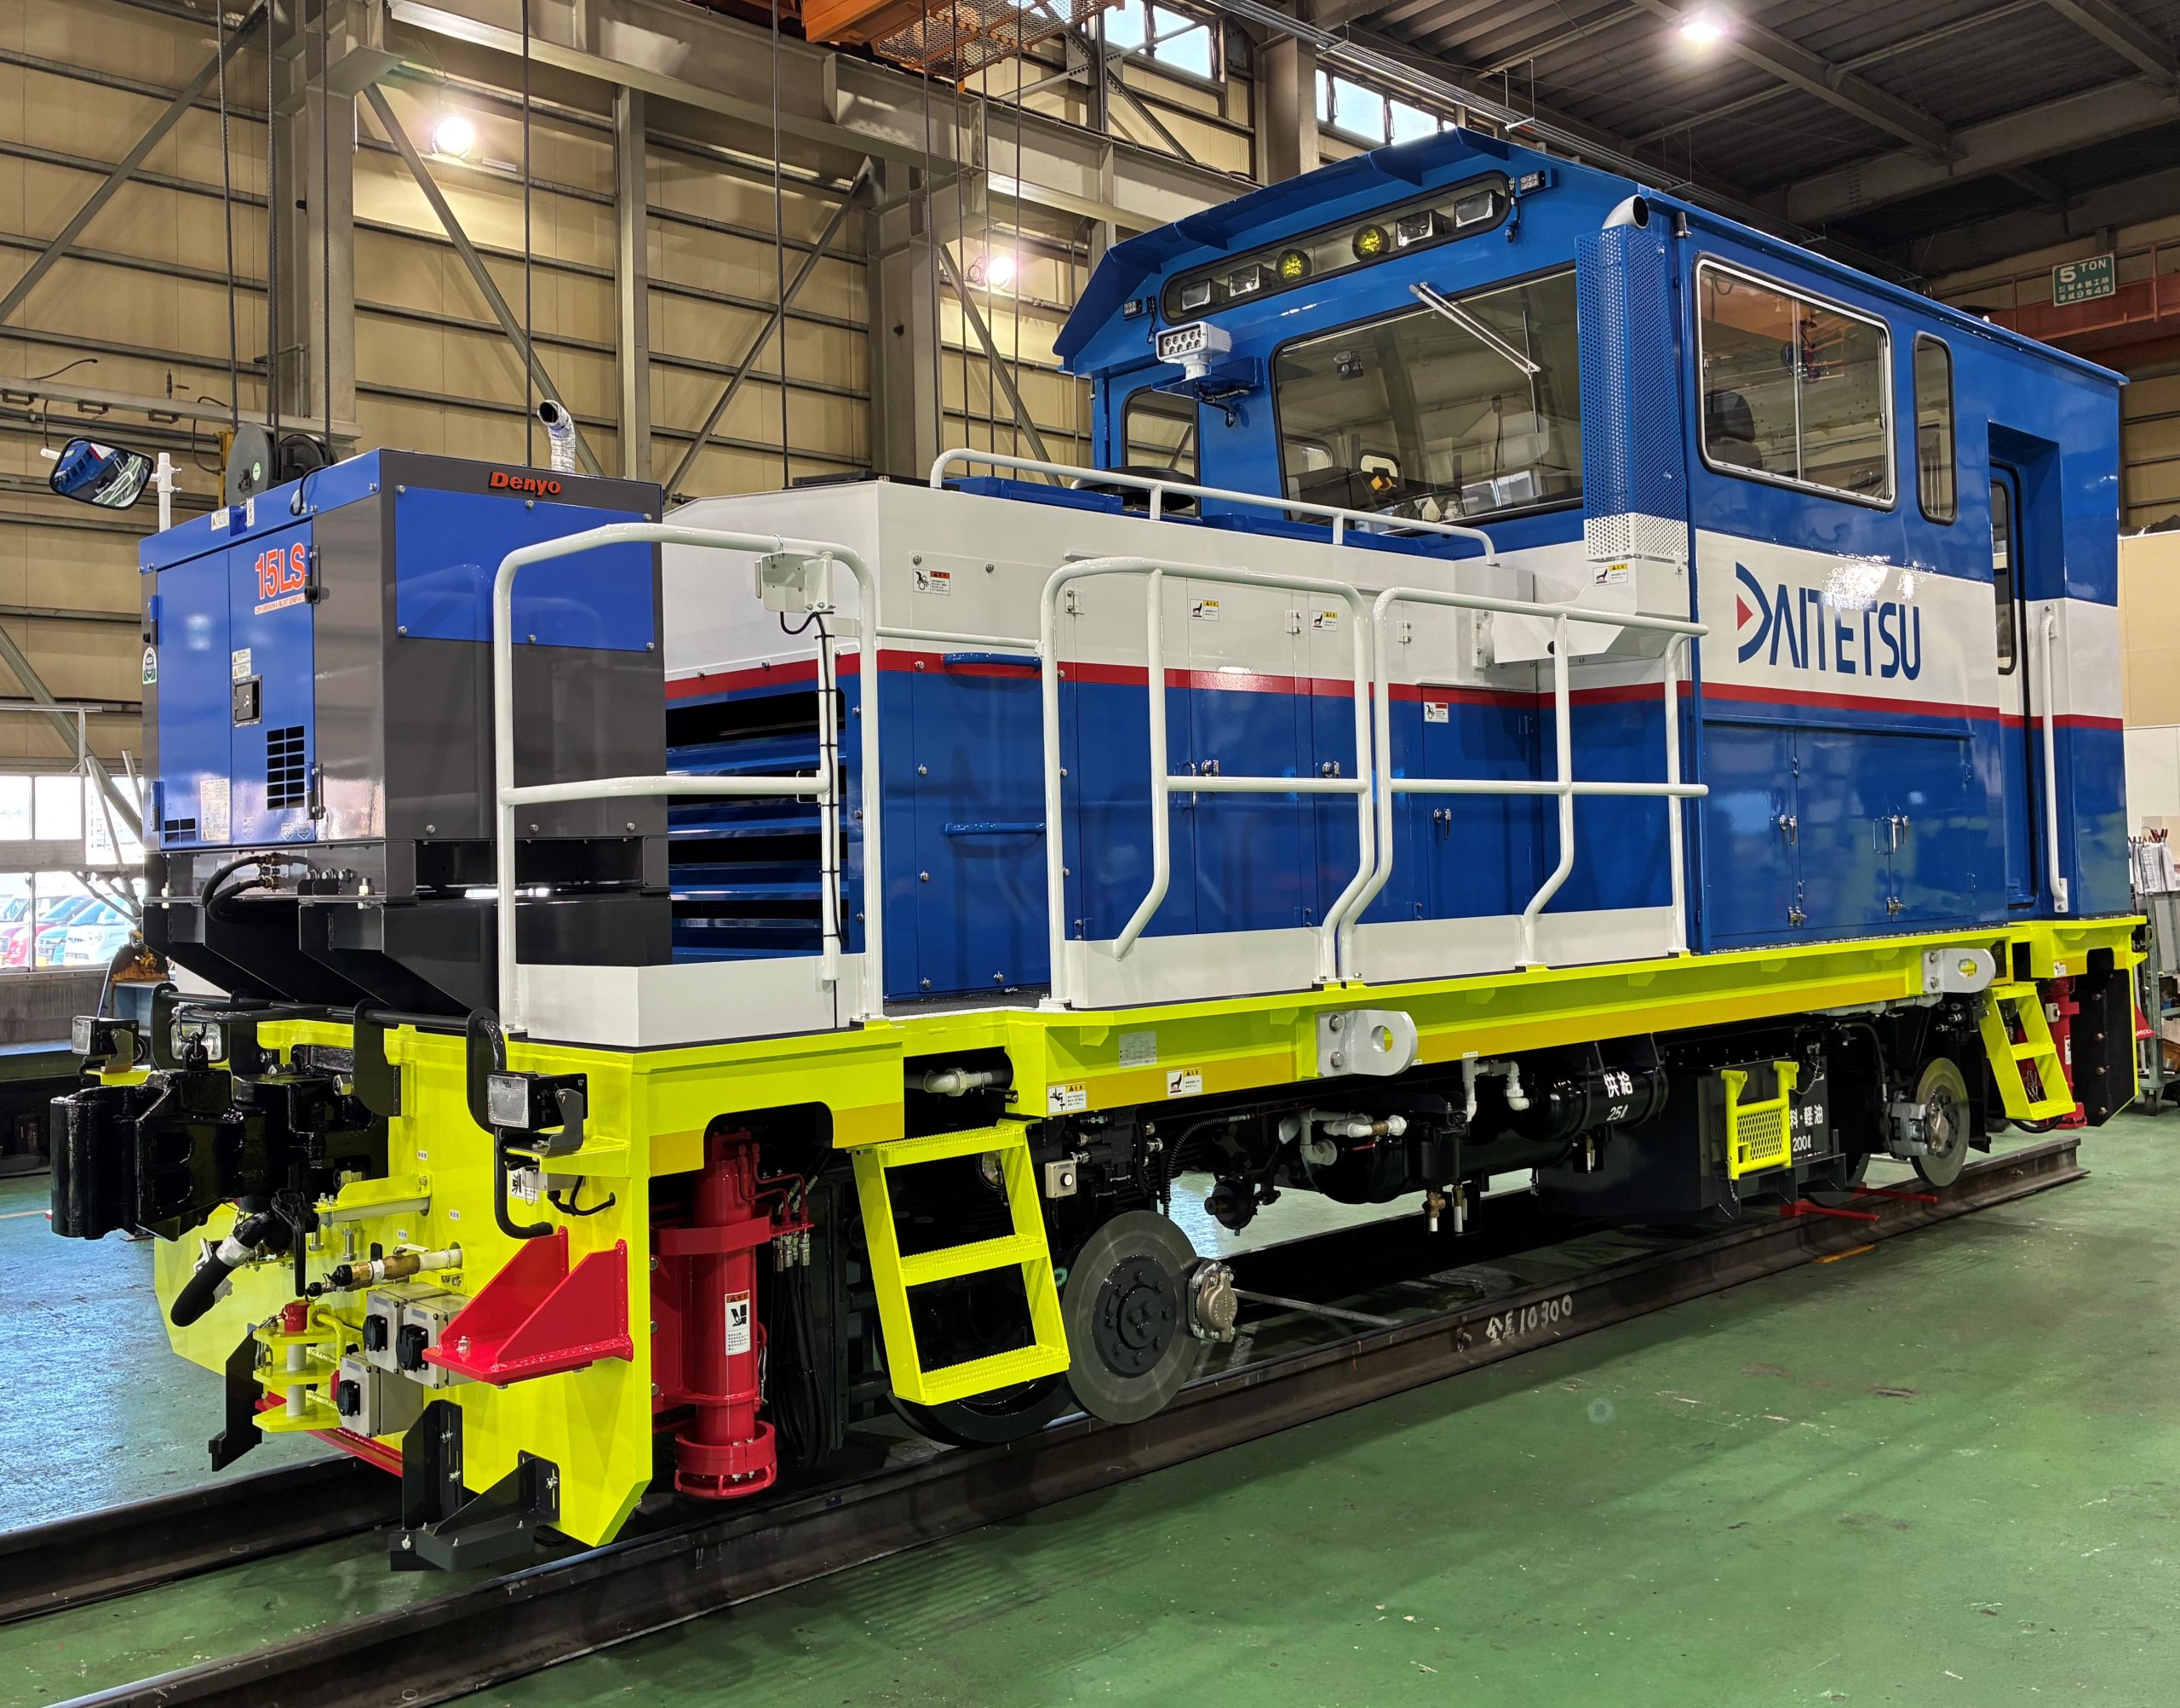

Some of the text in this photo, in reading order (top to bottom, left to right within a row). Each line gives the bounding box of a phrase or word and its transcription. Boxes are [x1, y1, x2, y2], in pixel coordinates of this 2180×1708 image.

[2059, 258, 2108, 284] 5 TON
[489, 471, 562, 497] Denyo
[255, 542, 306, 600] 15LS
[1735, 561, 1921, 681] DAITETSU
[1603, 1070, 1633, 1098] 供給
